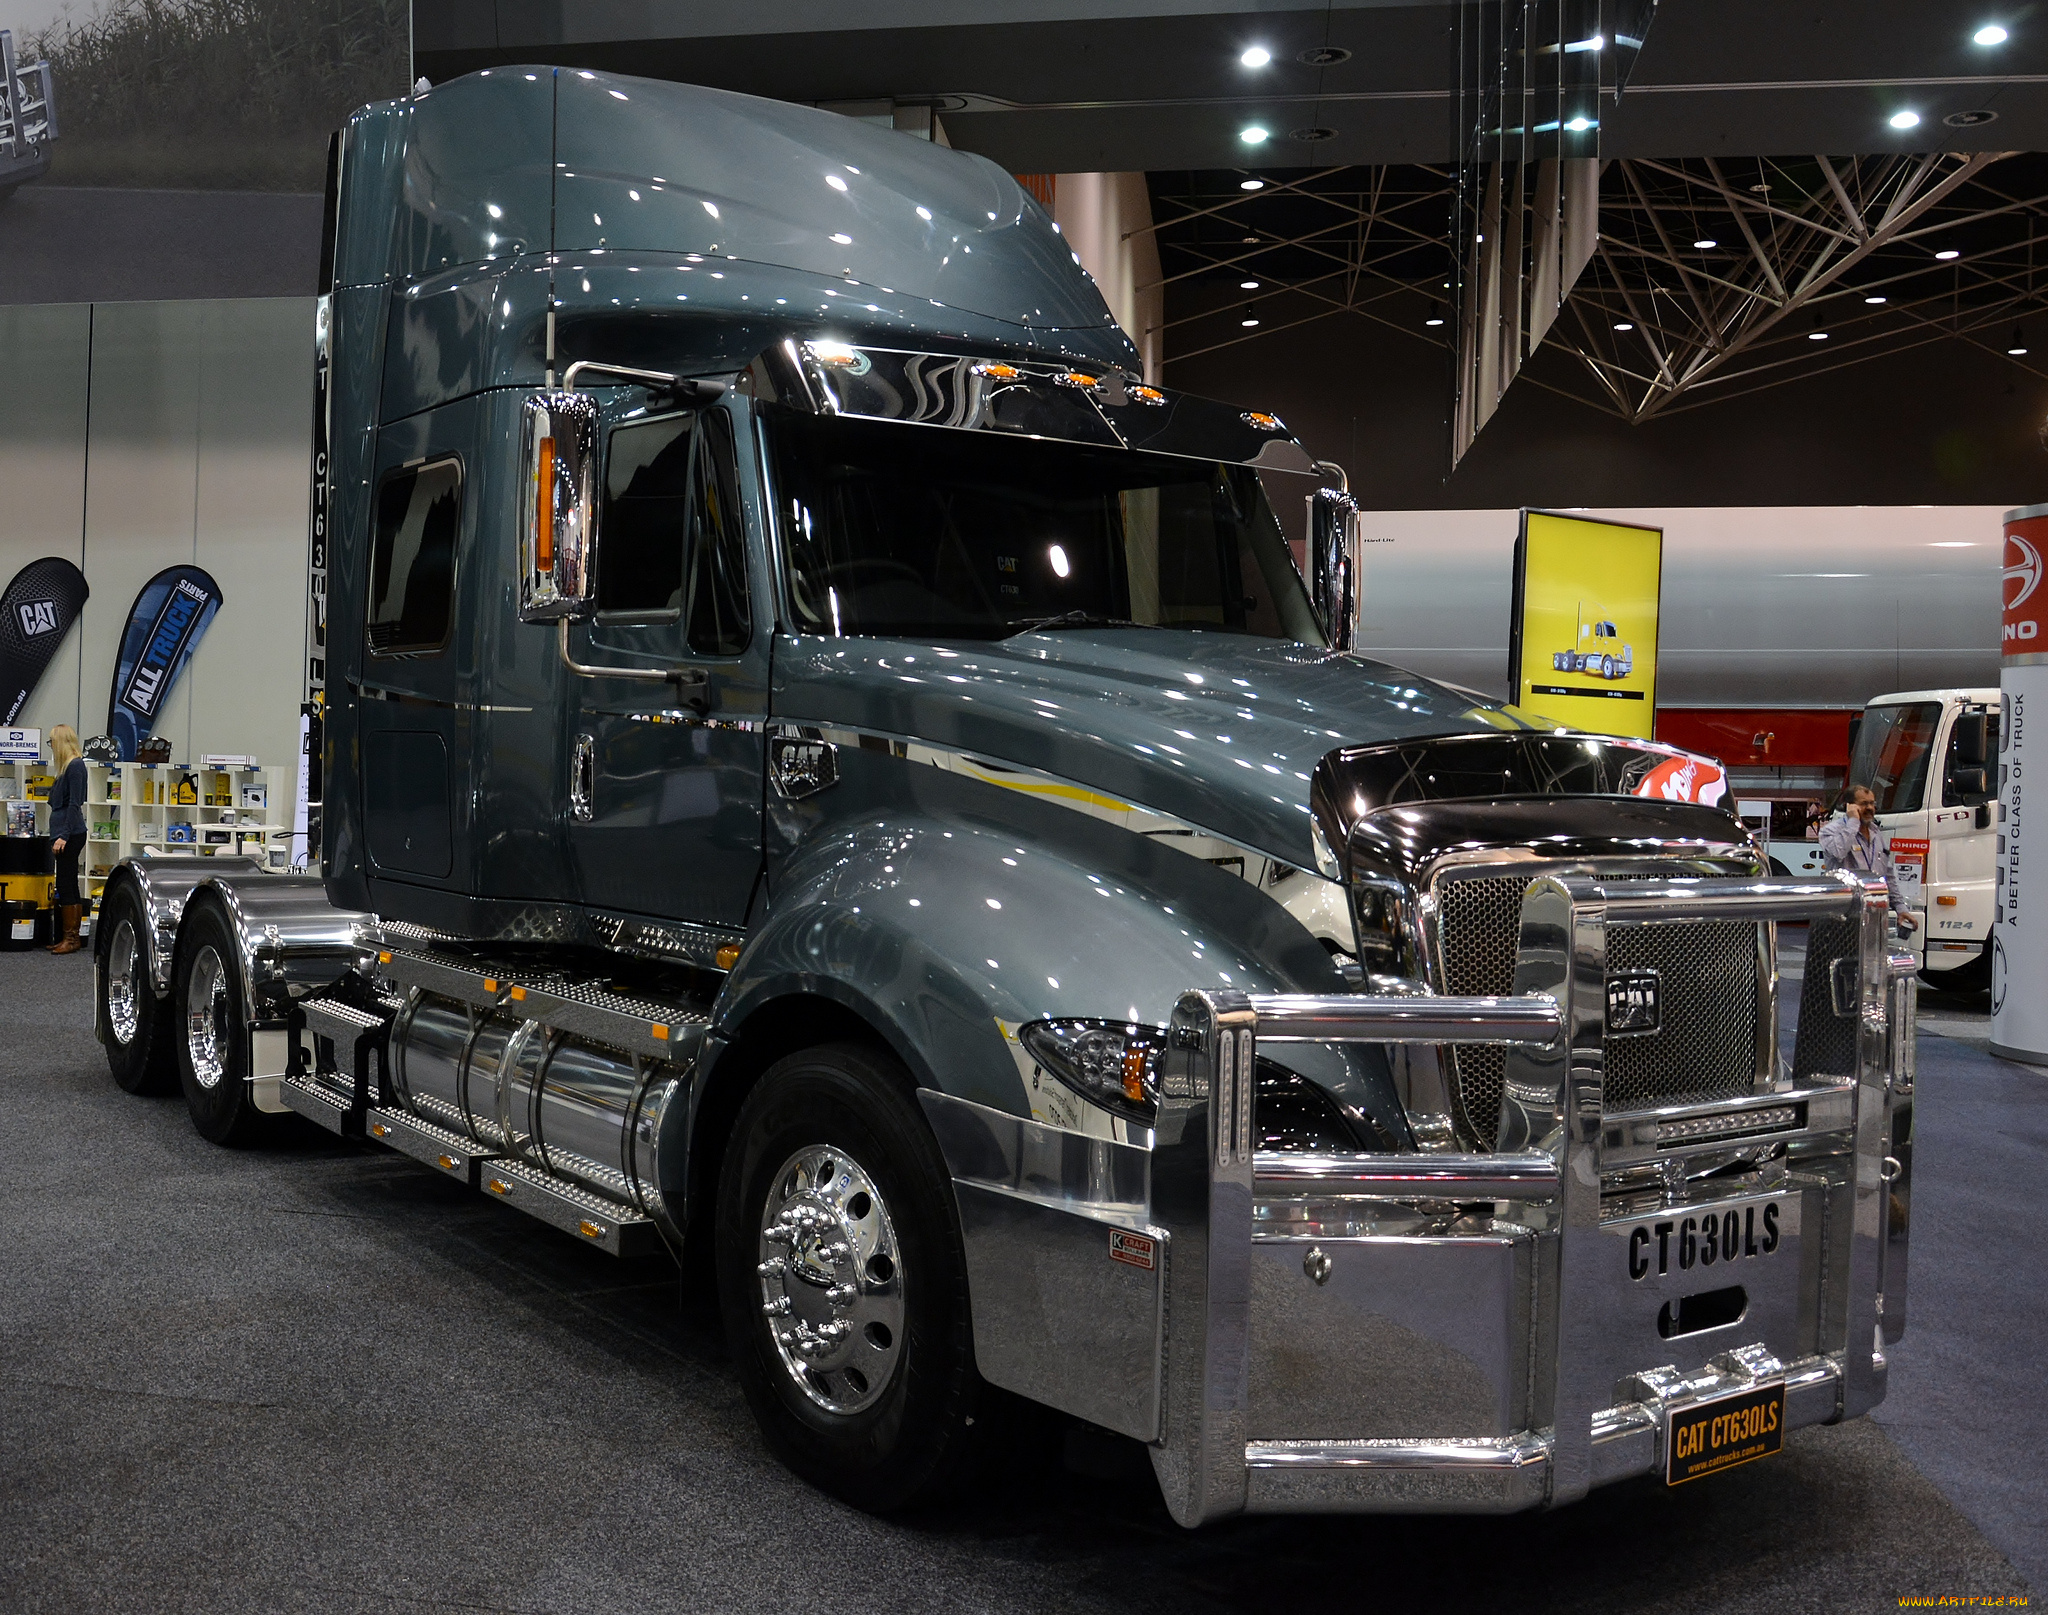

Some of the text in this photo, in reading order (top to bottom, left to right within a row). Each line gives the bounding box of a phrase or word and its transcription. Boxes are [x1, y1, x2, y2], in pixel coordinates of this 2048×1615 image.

[318, 307, 329, 390] CAT
[997, 556, 1016, 572] CAT
[179, 579, 209, 600] PARTS
[19, 601, 57, 636] CAT
[2001, 620, 2038, 641] INO
[130, 593, 199, 711] ALL TRUCK
[781, 745, 823, 785] CAT
[2008, 693, 2024, 927] A BETTER CLASS OF TRUCK
[1939, 920, 1974, 930] 1124
[1608, 979, 1656, 1029] CAT
[1628, 1202, 1779, 1282] CT630LS
[1676, 1400, 1778, 1459] CAT CT630LS
[1687, 1443, 1766, 1474] www.cattrucks.com.au
